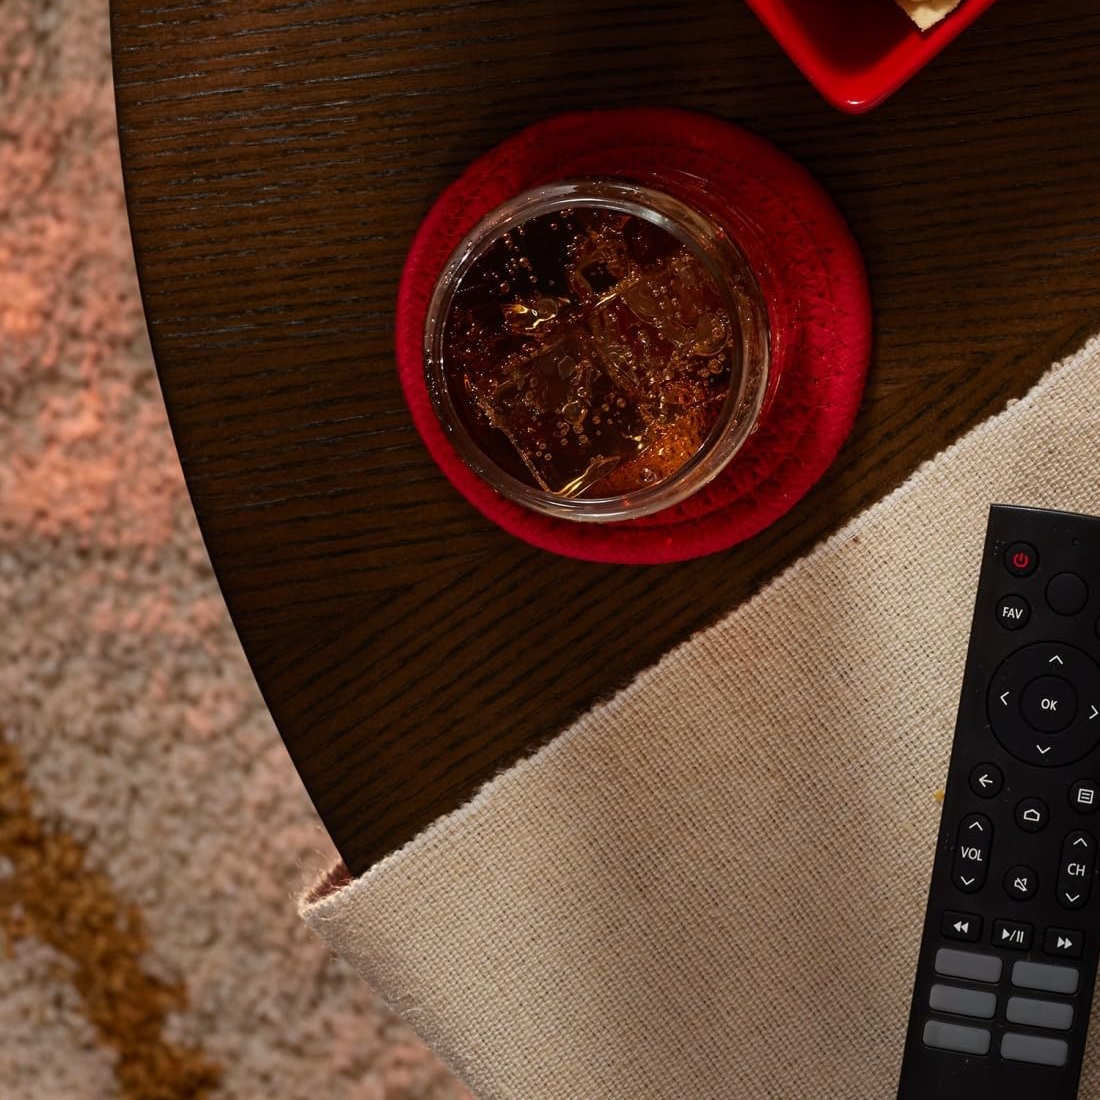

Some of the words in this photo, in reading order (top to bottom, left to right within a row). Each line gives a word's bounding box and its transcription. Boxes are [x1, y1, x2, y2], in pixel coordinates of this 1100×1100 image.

[1002, 606, 1024, 620] FAV
[1041, 698, 1058, 711] OK
[960, 846, 983, 862] VOL
[1067, 863, 1086, 877] CH
